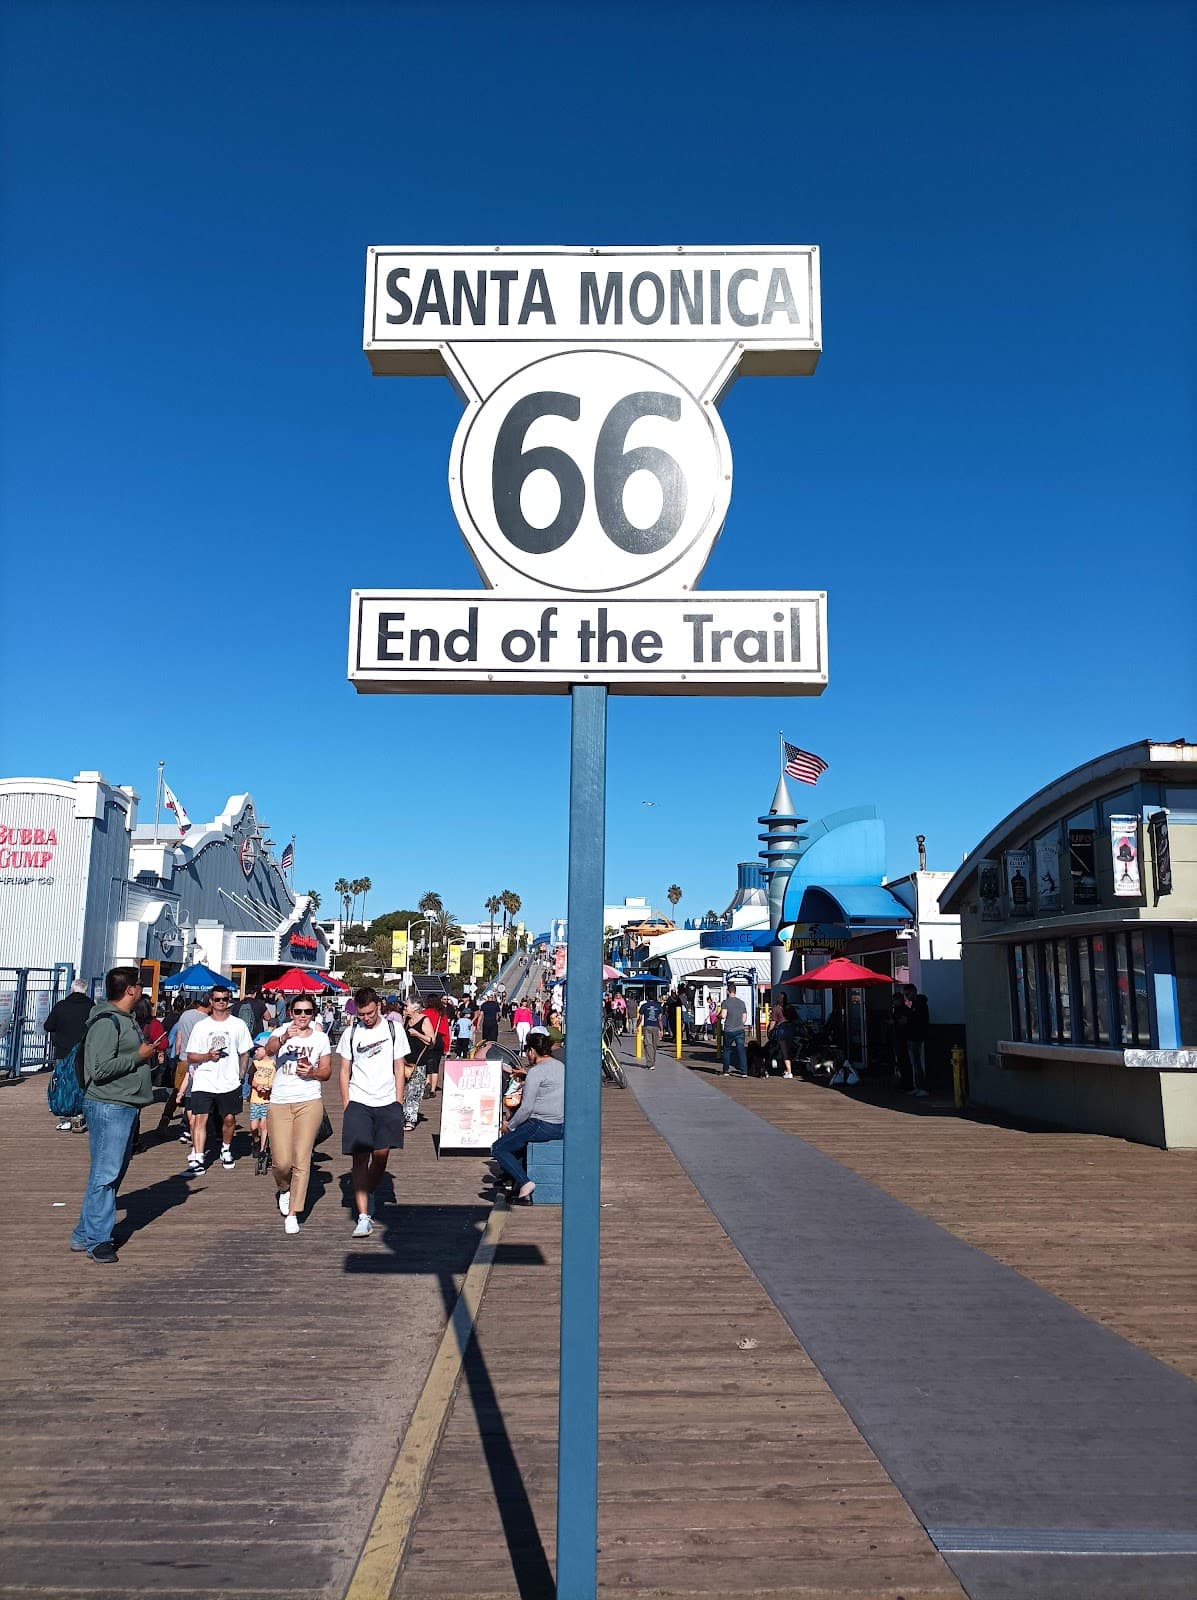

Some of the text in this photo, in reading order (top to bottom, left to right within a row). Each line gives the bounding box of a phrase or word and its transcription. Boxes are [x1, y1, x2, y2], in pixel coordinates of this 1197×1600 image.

[385, 267, 801, 327] SANTA MONICA
[491, 390, 688, 555] 66
[376, 606, 801, 663] End of the Trail
[286, 1044, 314, 1058] STAY
